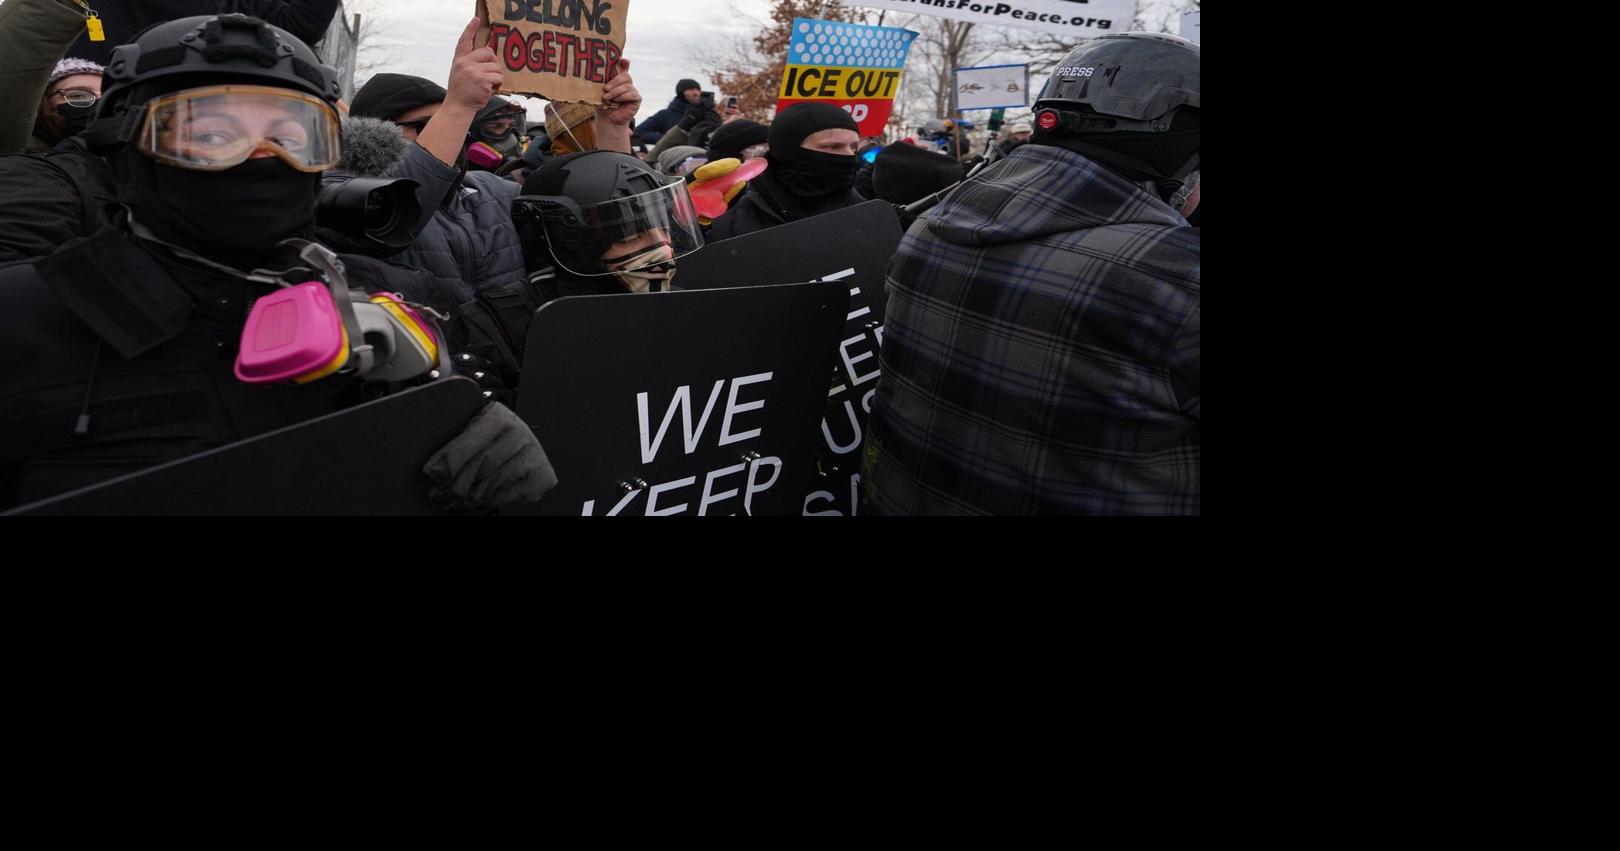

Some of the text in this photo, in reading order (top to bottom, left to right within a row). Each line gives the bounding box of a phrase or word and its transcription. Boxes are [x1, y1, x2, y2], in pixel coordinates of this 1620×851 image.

[504, 0, 612, 35] BELONG
[488, 22, 621, 84] TOGETHER
[784, 67, 900, 98] ICE OUT
[1056, 66, 1095, 77] PRESS
[637, 372, 774, 465] WE
